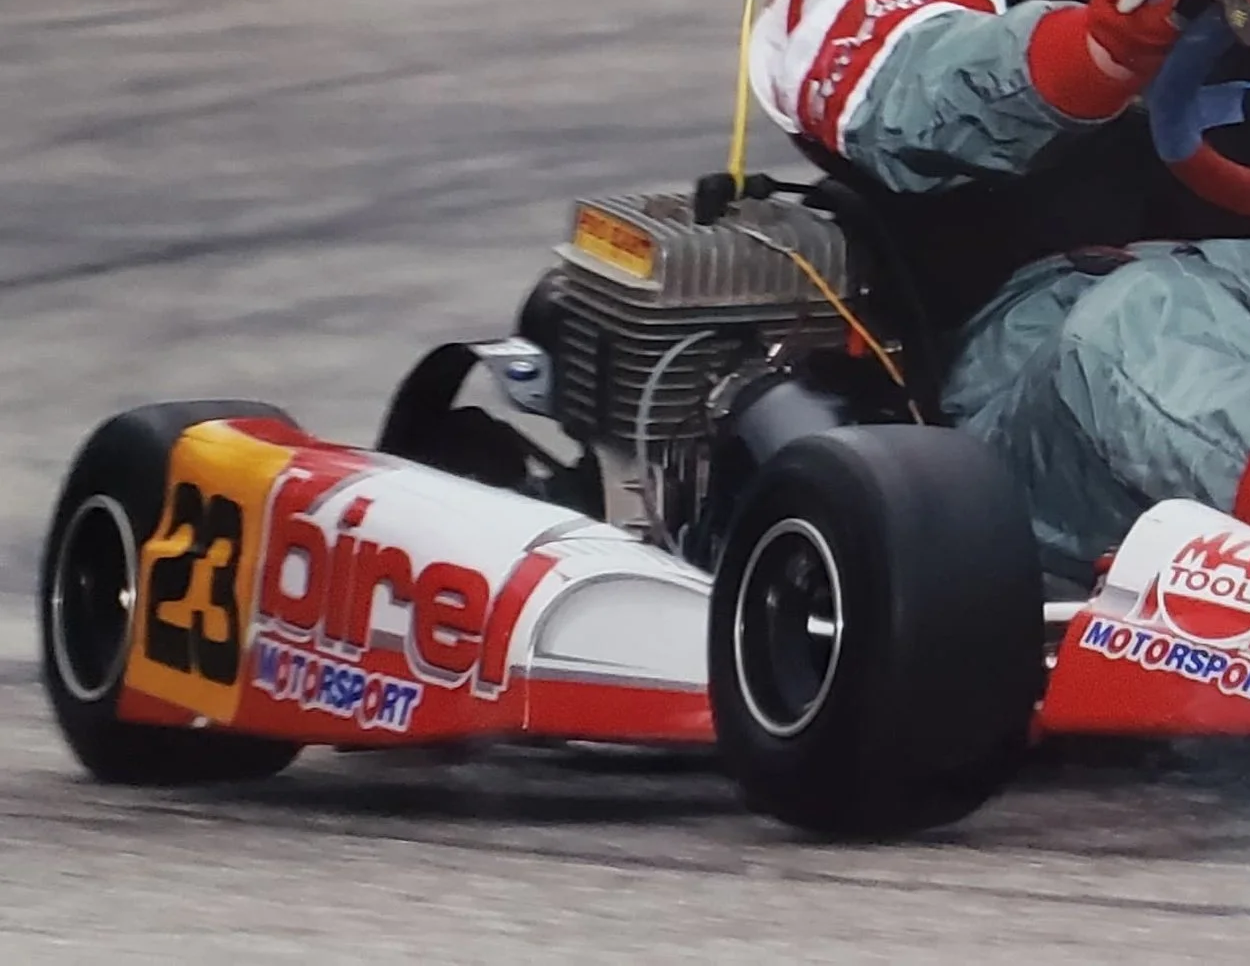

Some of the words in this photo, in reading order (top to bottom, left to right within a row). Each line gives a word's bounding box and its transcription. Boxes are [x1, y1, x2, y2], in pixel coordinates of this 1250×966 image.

[145, 481, 243, 686] 23
[259, 470, 560, 692] birel
[255, 641, 420, 730] MOTORSPORT
